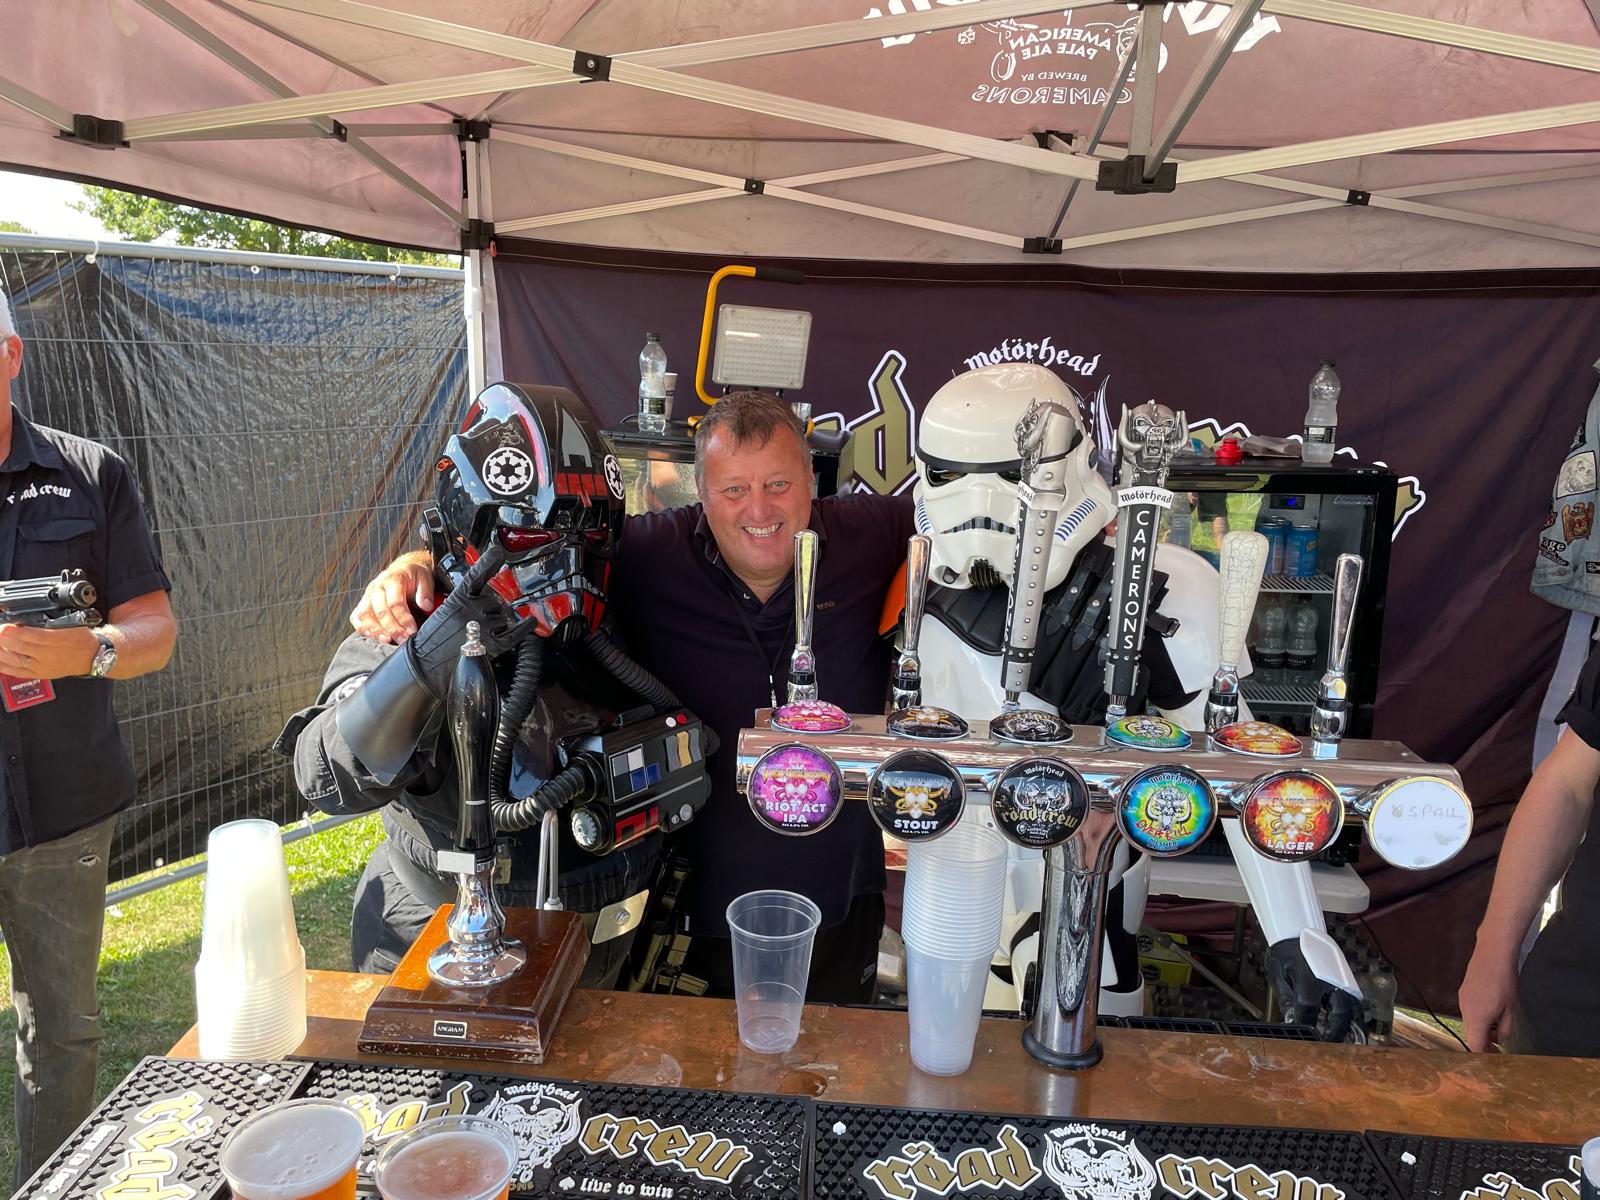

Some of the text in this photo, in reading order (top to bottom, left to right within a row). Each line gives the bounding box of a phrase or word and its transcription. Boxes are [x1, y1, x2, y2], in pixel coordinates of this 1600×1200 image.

[6, 482, 72, 504] rad crew
[1123, 510, 1150, 651] CAMERONS
[765, 801, 827, 813] RIOT ACT
[783, 813, 808, 823] IPA
[894, 819, 939, 830] STOUT
[1267, 839, 1315, 851] LAGER
[437, 1024, 464, 1034] ANGRAM
[578, 1112, 755, 1185] crew
[579, 1177, 674, 1199] live to win
